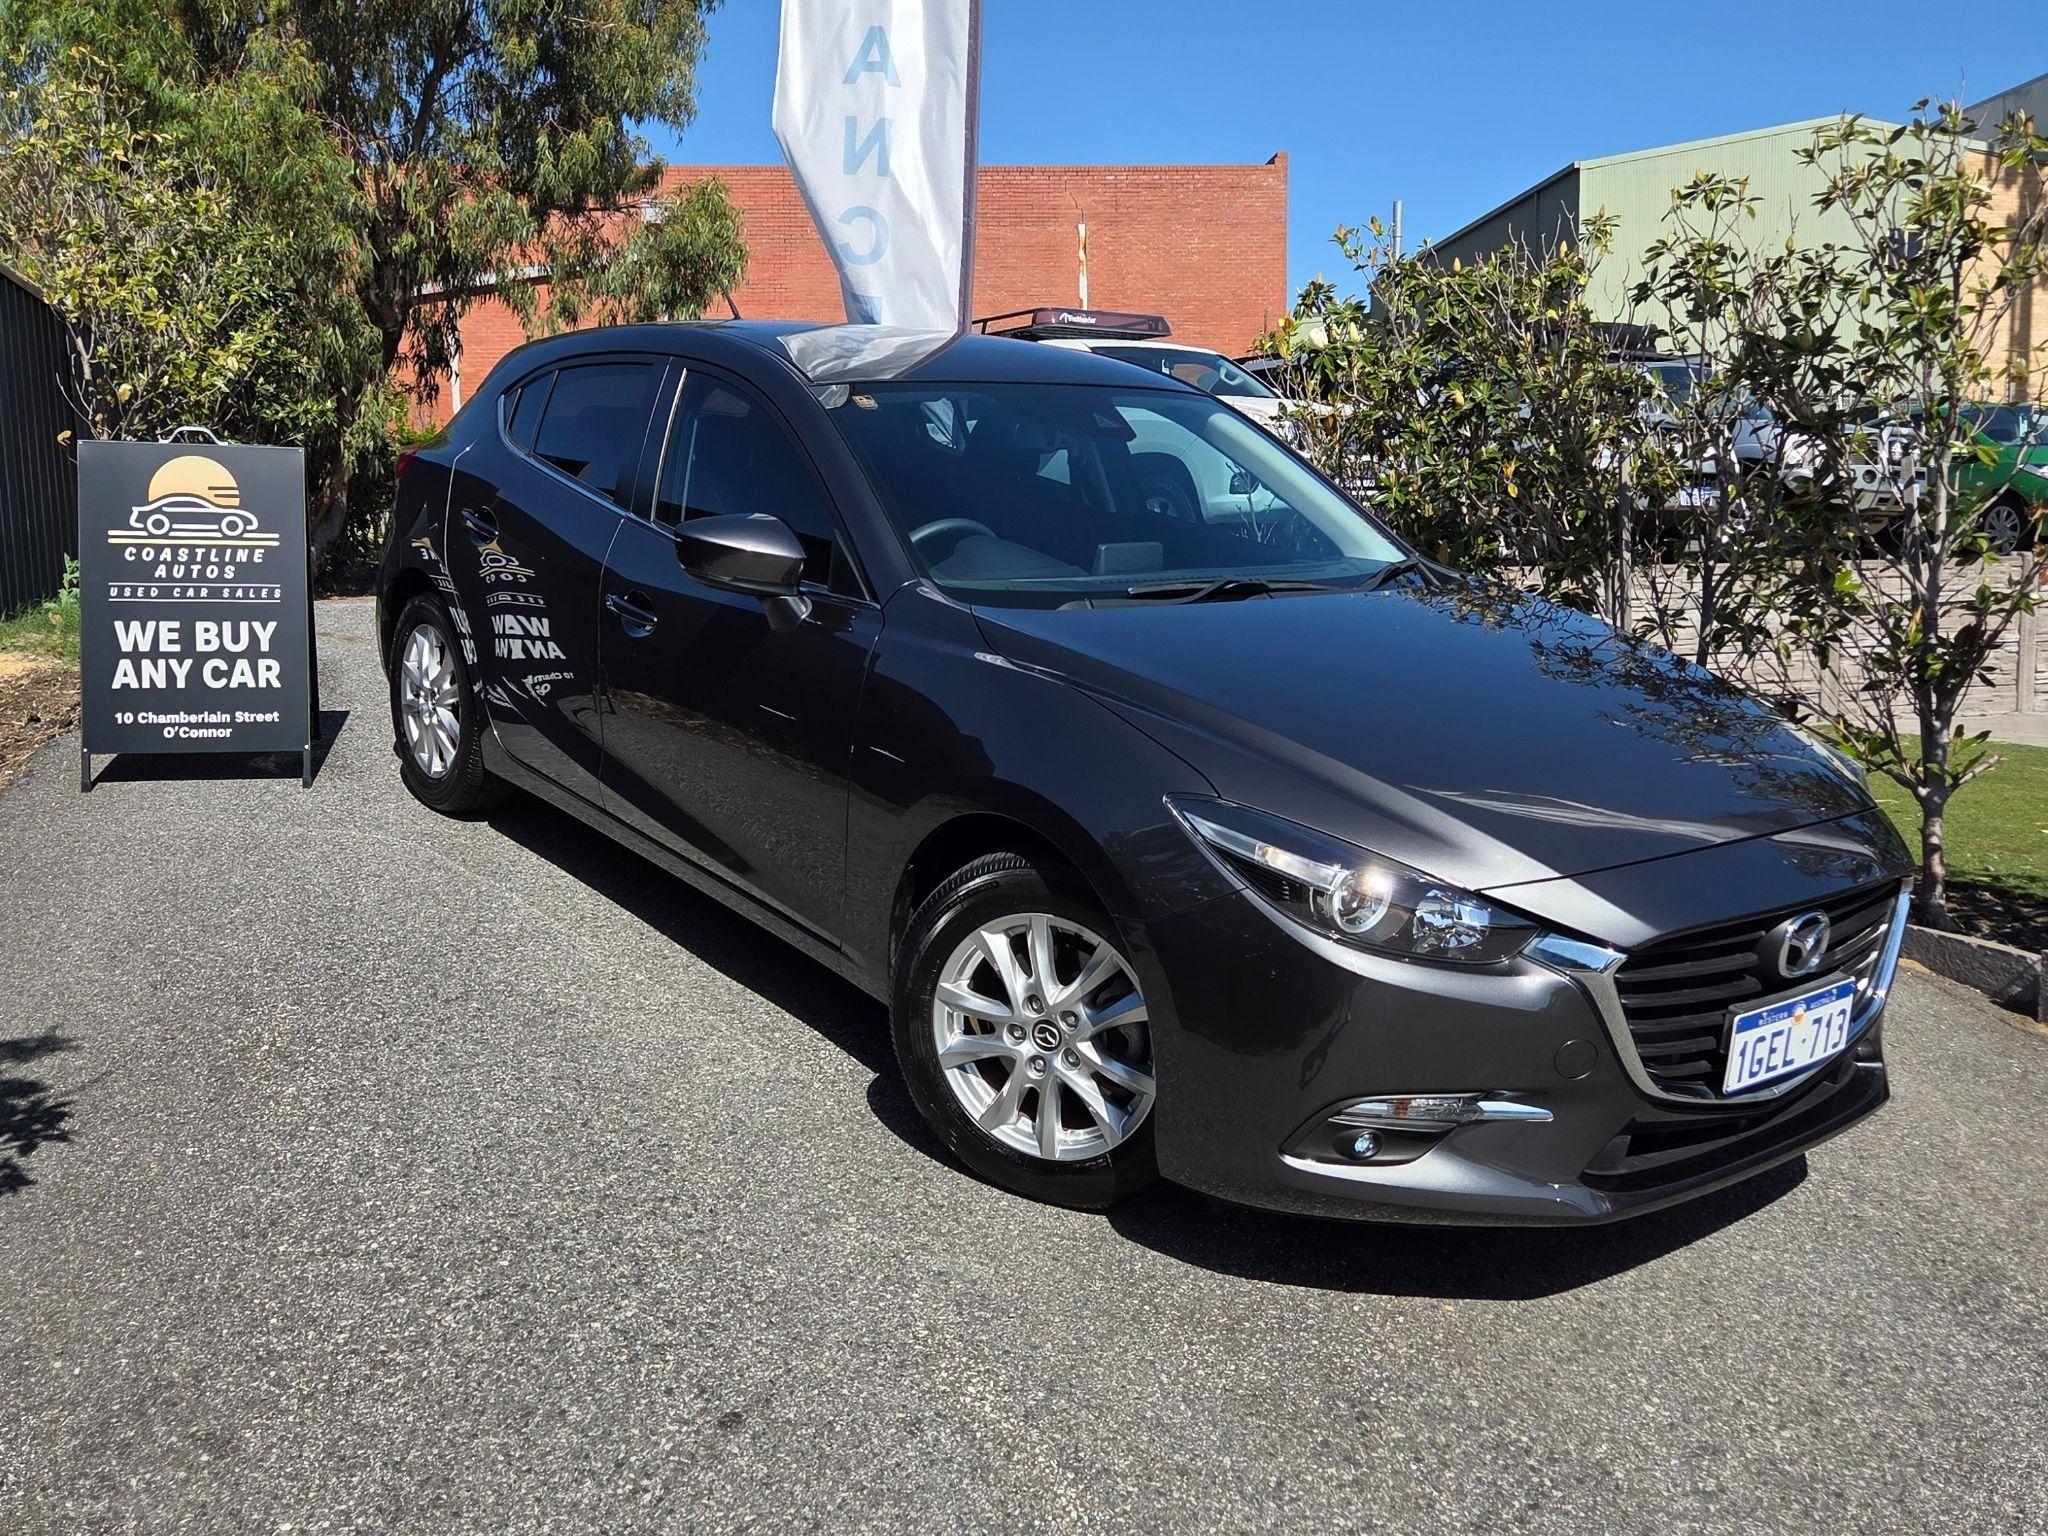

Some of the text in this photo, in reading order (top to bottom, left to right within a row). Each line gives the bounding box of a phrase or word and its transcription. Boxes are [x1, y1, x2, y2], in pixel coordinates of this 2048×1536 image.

[124, 547, 265, 563] COASTLINE
[155, 564, 236, 579] AUTOS
[110, 587, 282, 599] USED CAR SALES
[114, 620, 278, 653] WE BUY
[111, 658, 282, 690] ANY CAR
[115, 711, 280, 725] 10 Chamberlain Street
[163, 726, 233, 739] O'Connor
